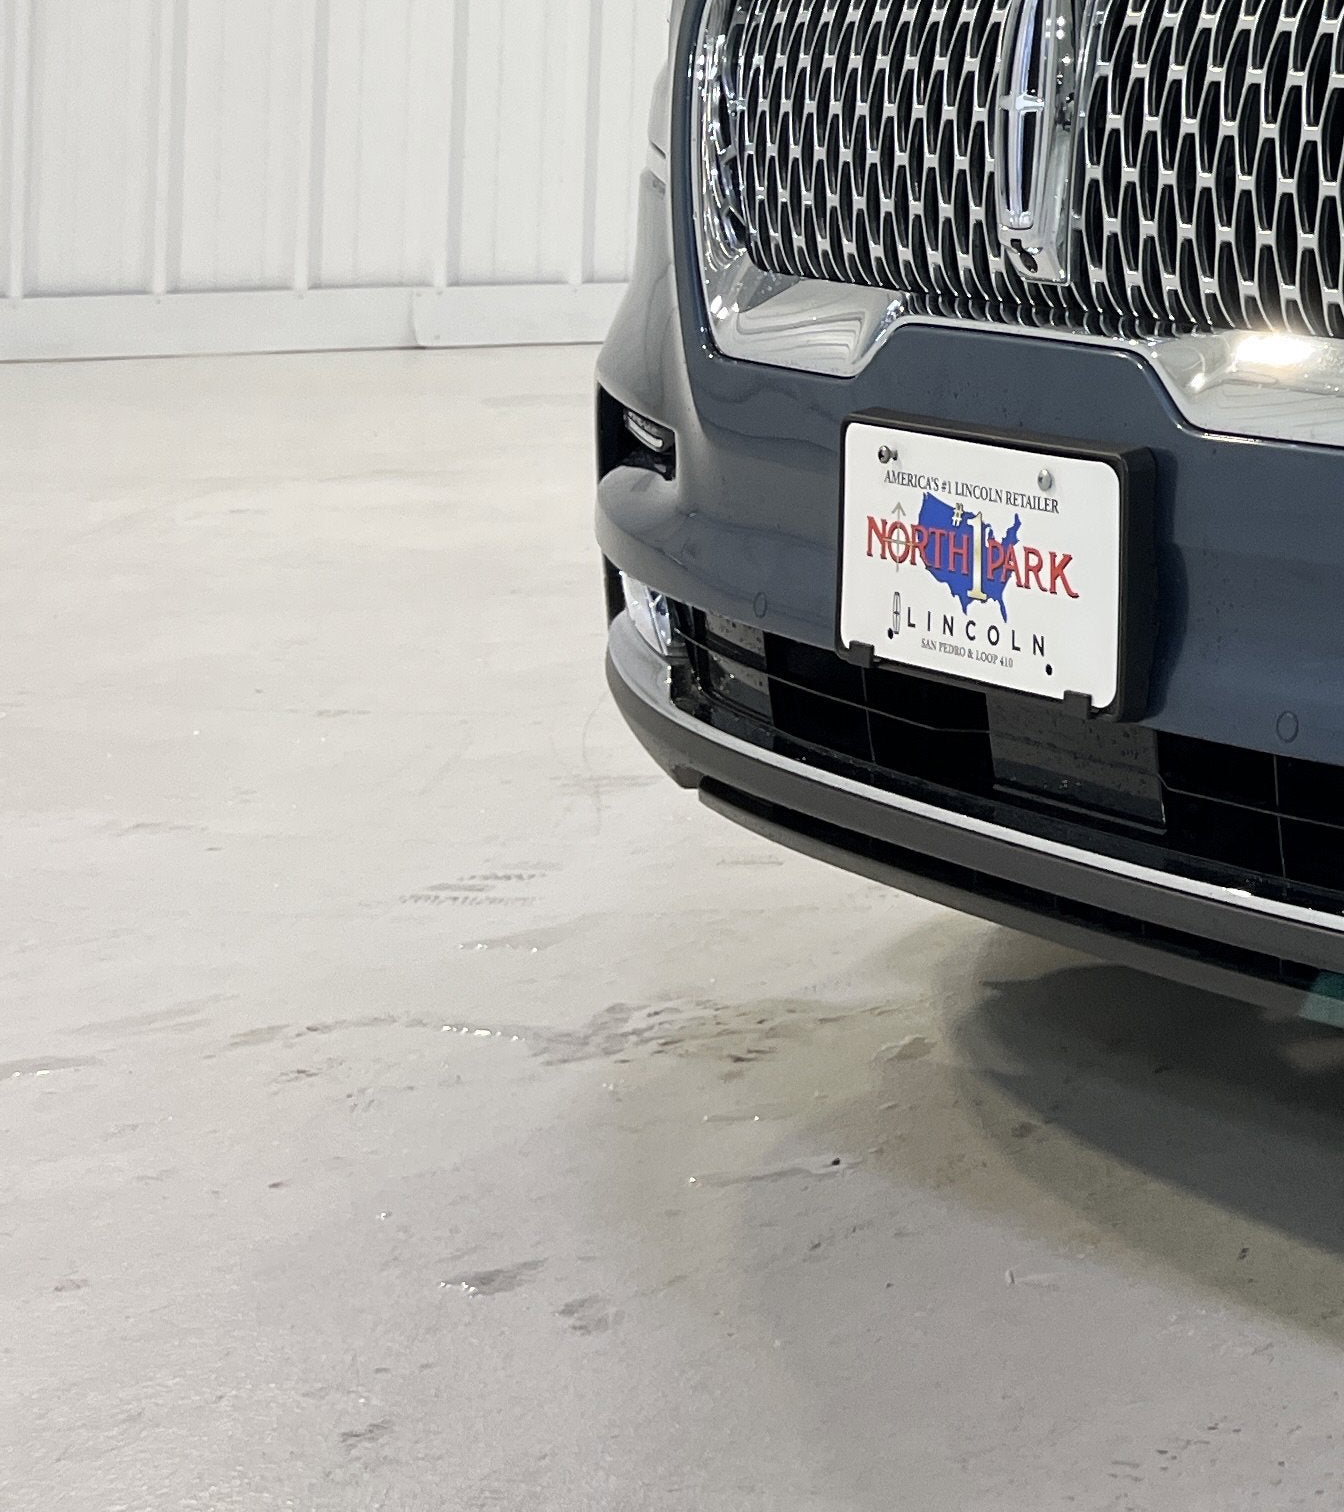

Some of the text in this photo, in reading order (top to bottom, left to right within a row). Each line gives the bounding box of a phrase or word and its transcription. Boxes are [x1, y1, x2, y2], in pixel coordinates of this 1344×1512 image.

[884, 469, 1060, 514] AMERICA'S #1 LINCOLN RETAILER
[866, 515, 1080, 599] NORTH PARK
[906, 606, 1046, 658] LINCOLN
[921, 638, 1014, 669] SAN PEDRO & LOOP 410
